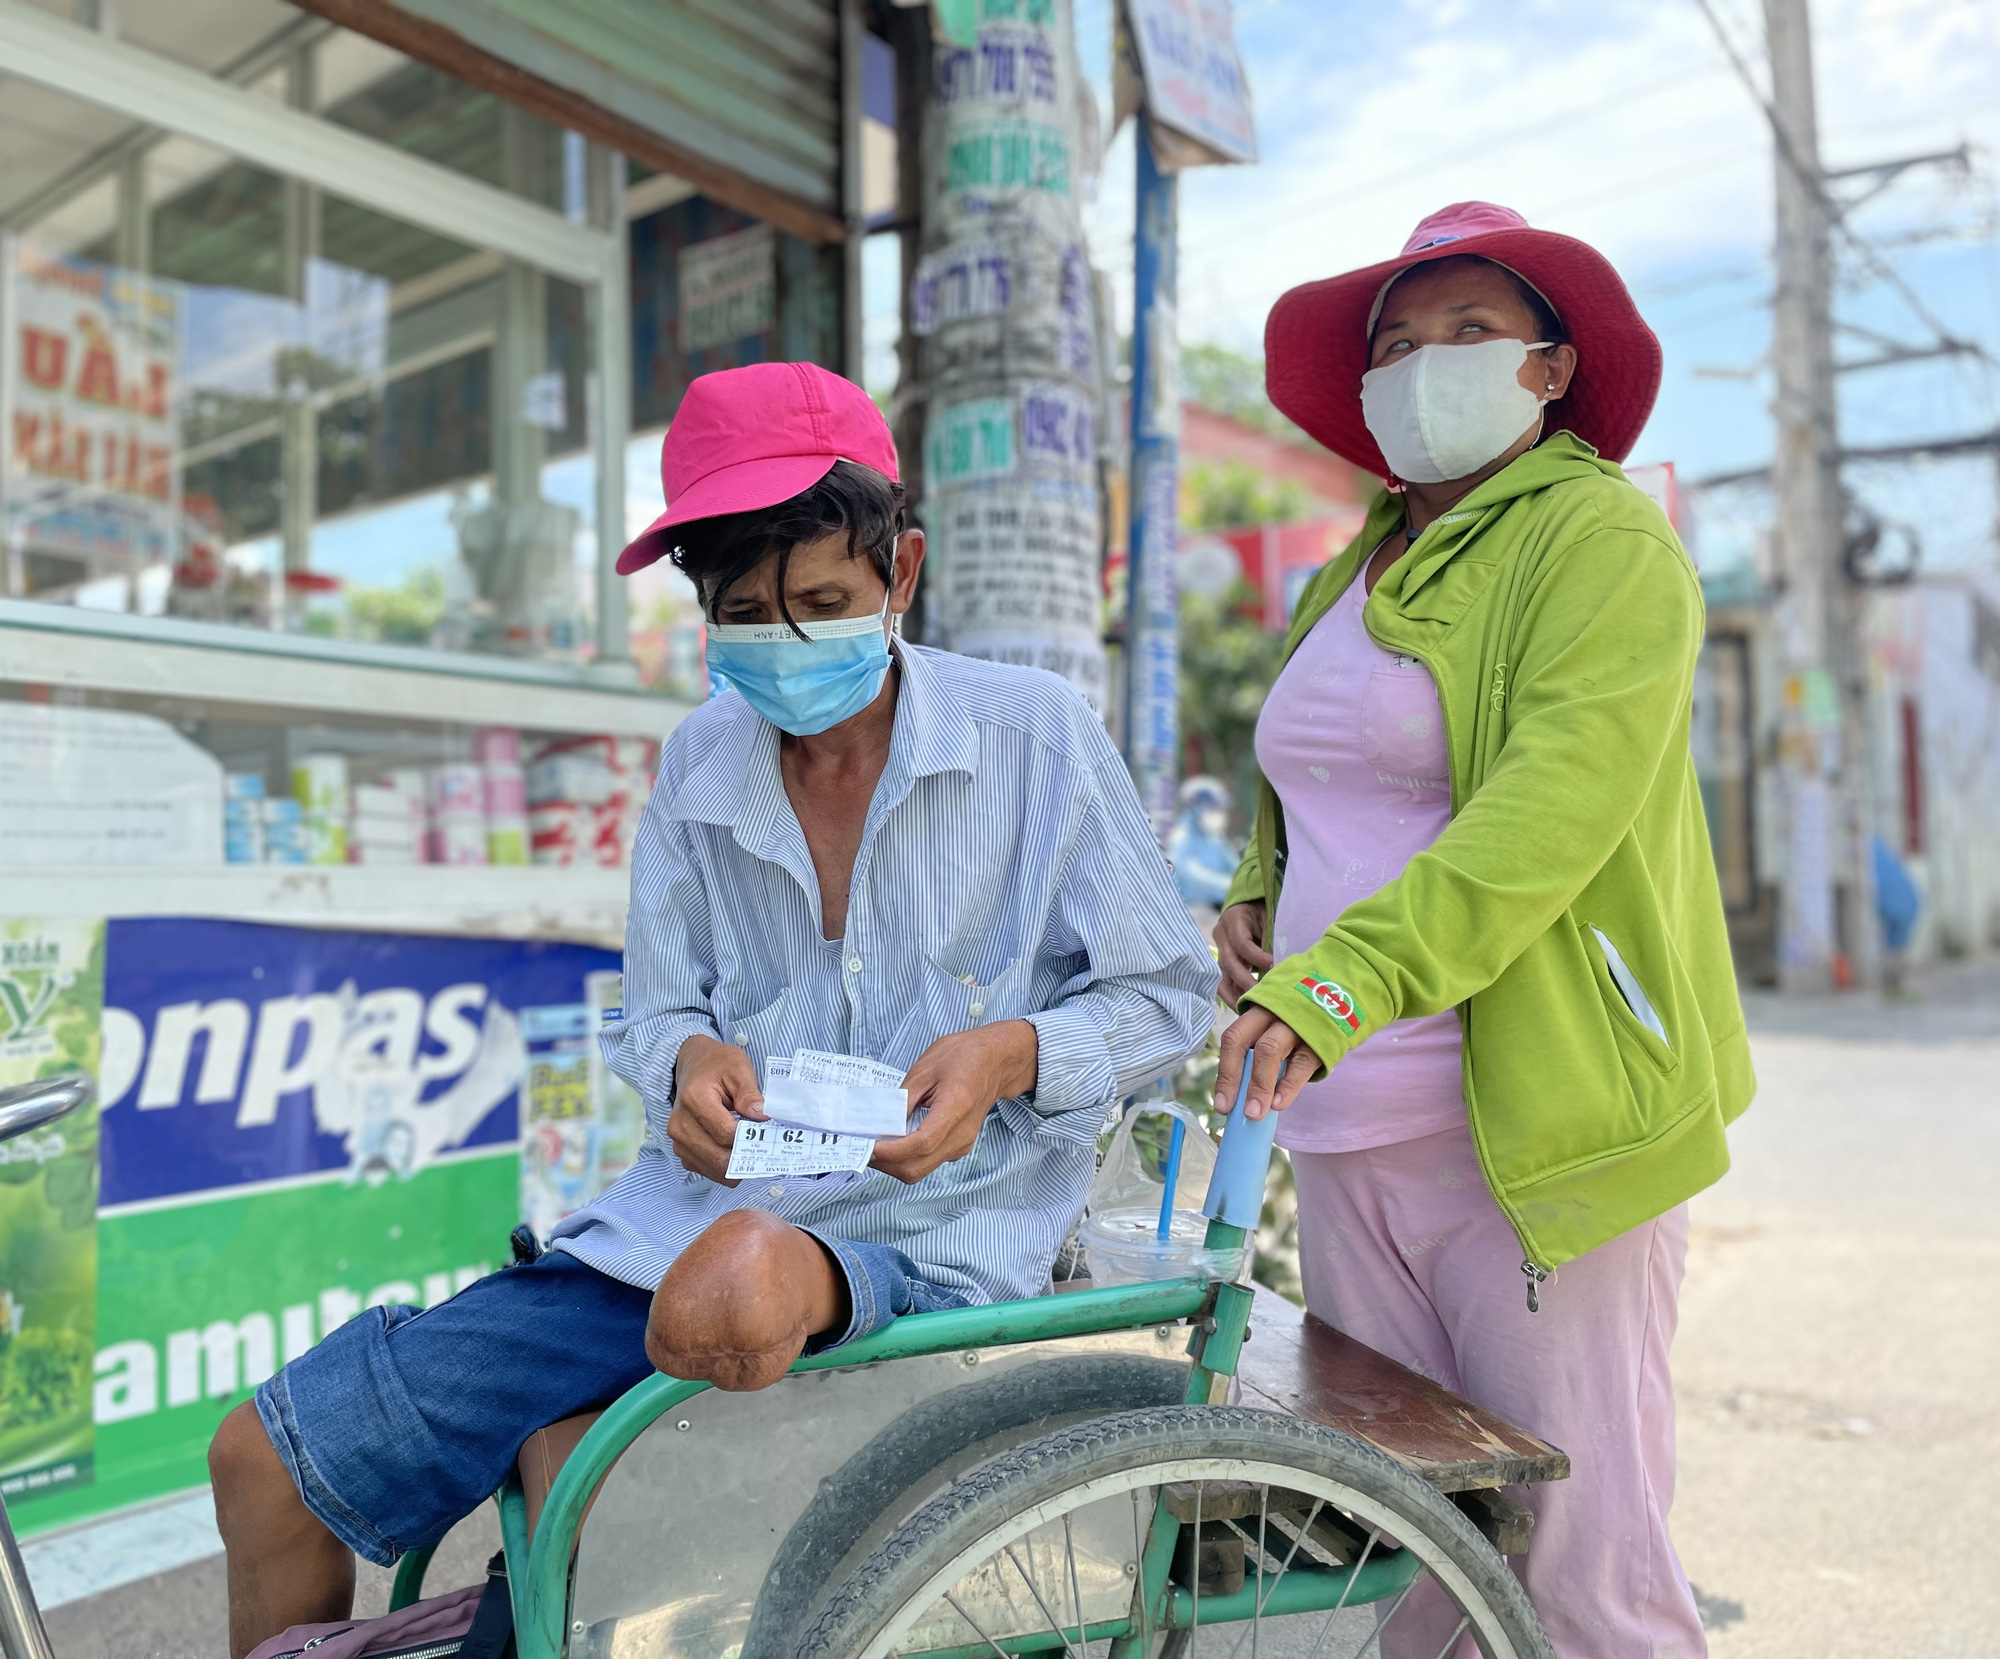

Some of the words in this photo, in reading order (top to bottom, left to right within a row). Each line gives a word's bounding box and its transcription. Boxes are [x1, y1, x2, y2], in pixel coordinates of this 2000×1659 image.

[754, 629, 801, 640] IET-ANH
[1376, 771, 1436, 789] Hello
[745, 1128, 766, 1141] 16
[782, 1129, 804, 1143] 79
